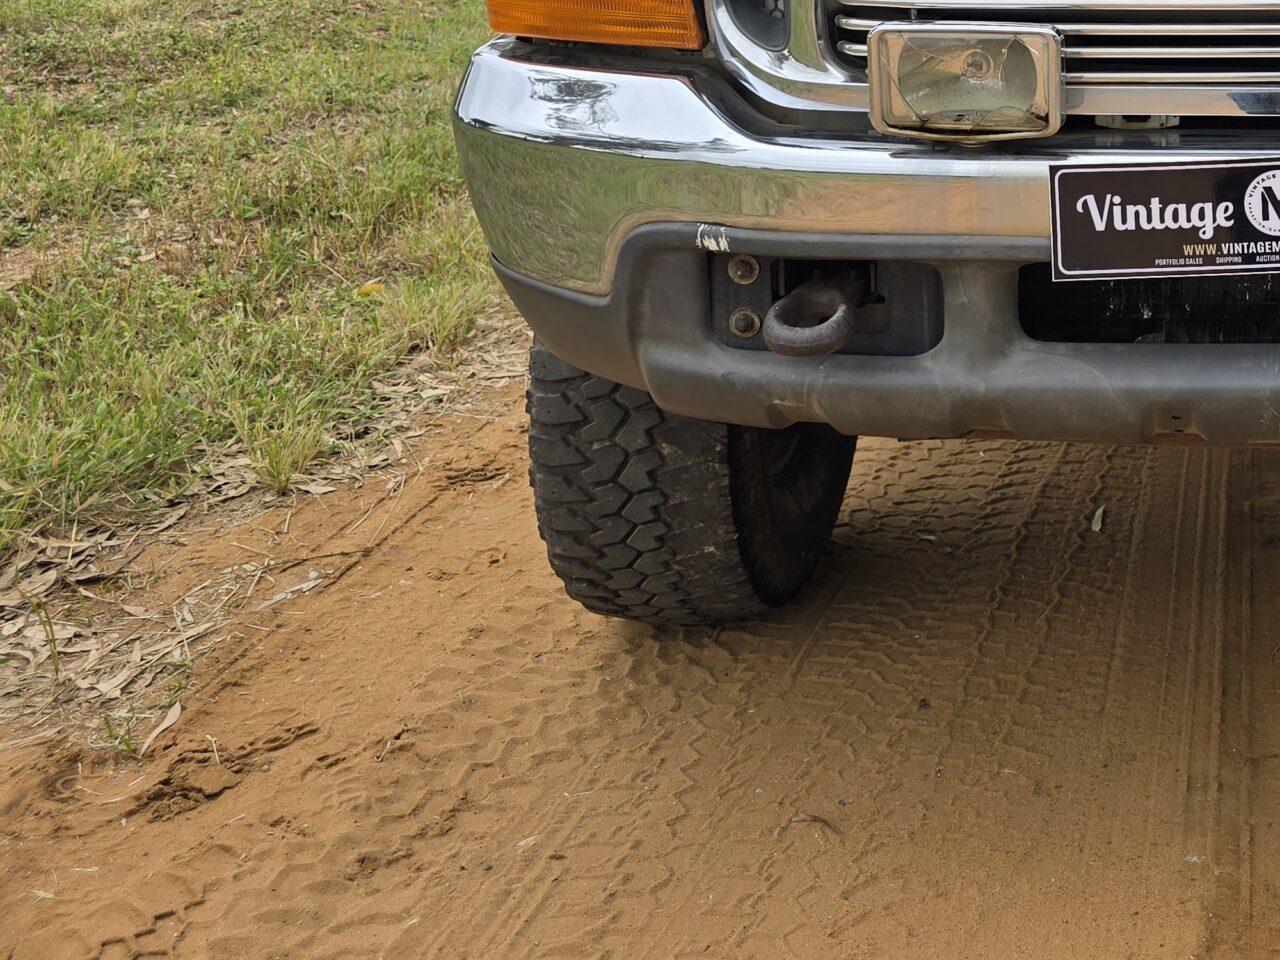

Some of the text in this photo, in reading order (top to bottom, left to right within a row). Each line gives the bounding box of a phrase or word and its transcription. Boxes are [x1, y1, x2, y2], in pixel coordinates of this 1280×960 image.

[1248, 173, 1276, 198] VINTAGE
[1076, 194, 1235, 240] Vintage
[1155, 257, 1203, 266] PORTFOLIO SALES
[1215, 256, 1242, 264] SHIPPING
[1255, 254, 1280, 262] AUCTION
